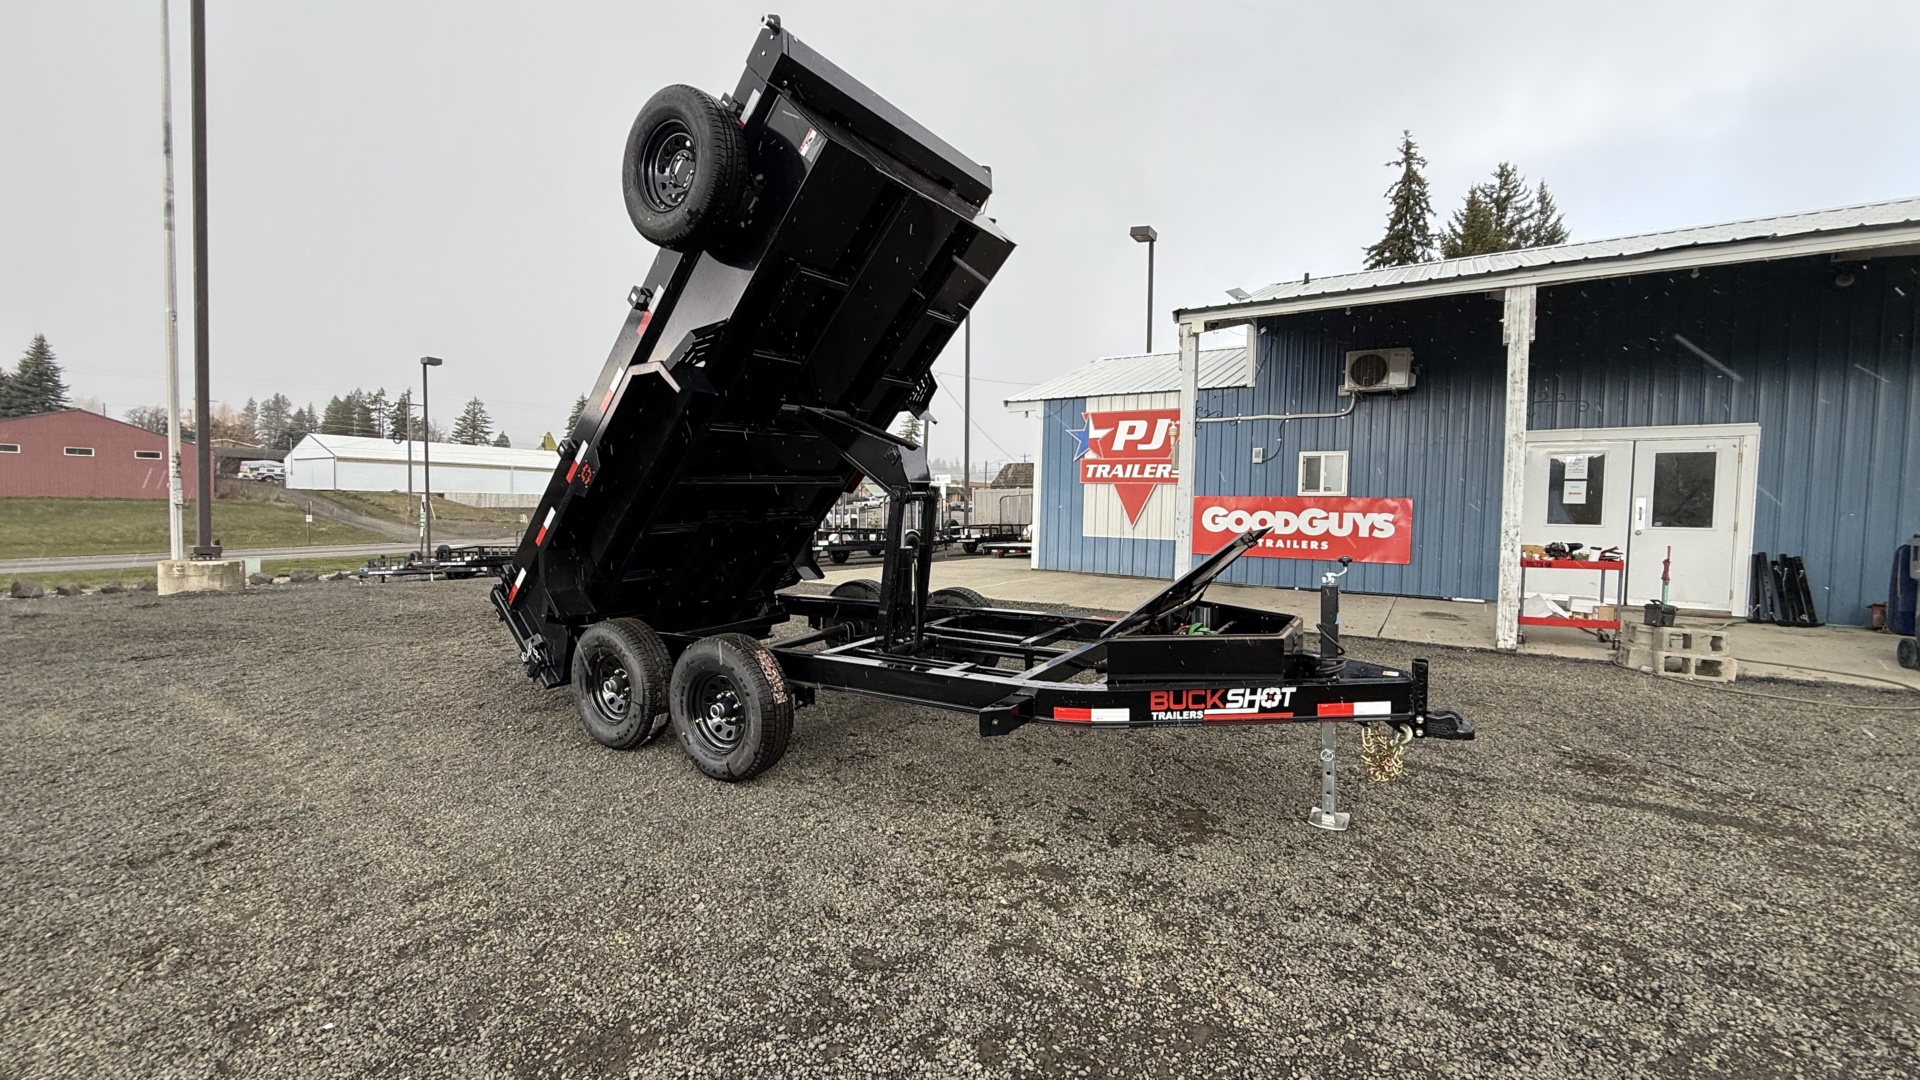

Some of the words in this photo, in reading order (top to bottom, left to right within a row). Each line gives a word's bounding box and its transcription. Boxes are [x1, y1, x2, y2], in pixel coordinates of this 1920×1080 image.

[1111, 418, 1171, 451] PJ
[1201, 505, 1396, 539] GOODGUYS
[1257, 538, 1329, 550] TRAILERS
[1150, 687, 1297, 711] BUCKSHOT
[1151, 710, 1204, 721] TRAILERS
